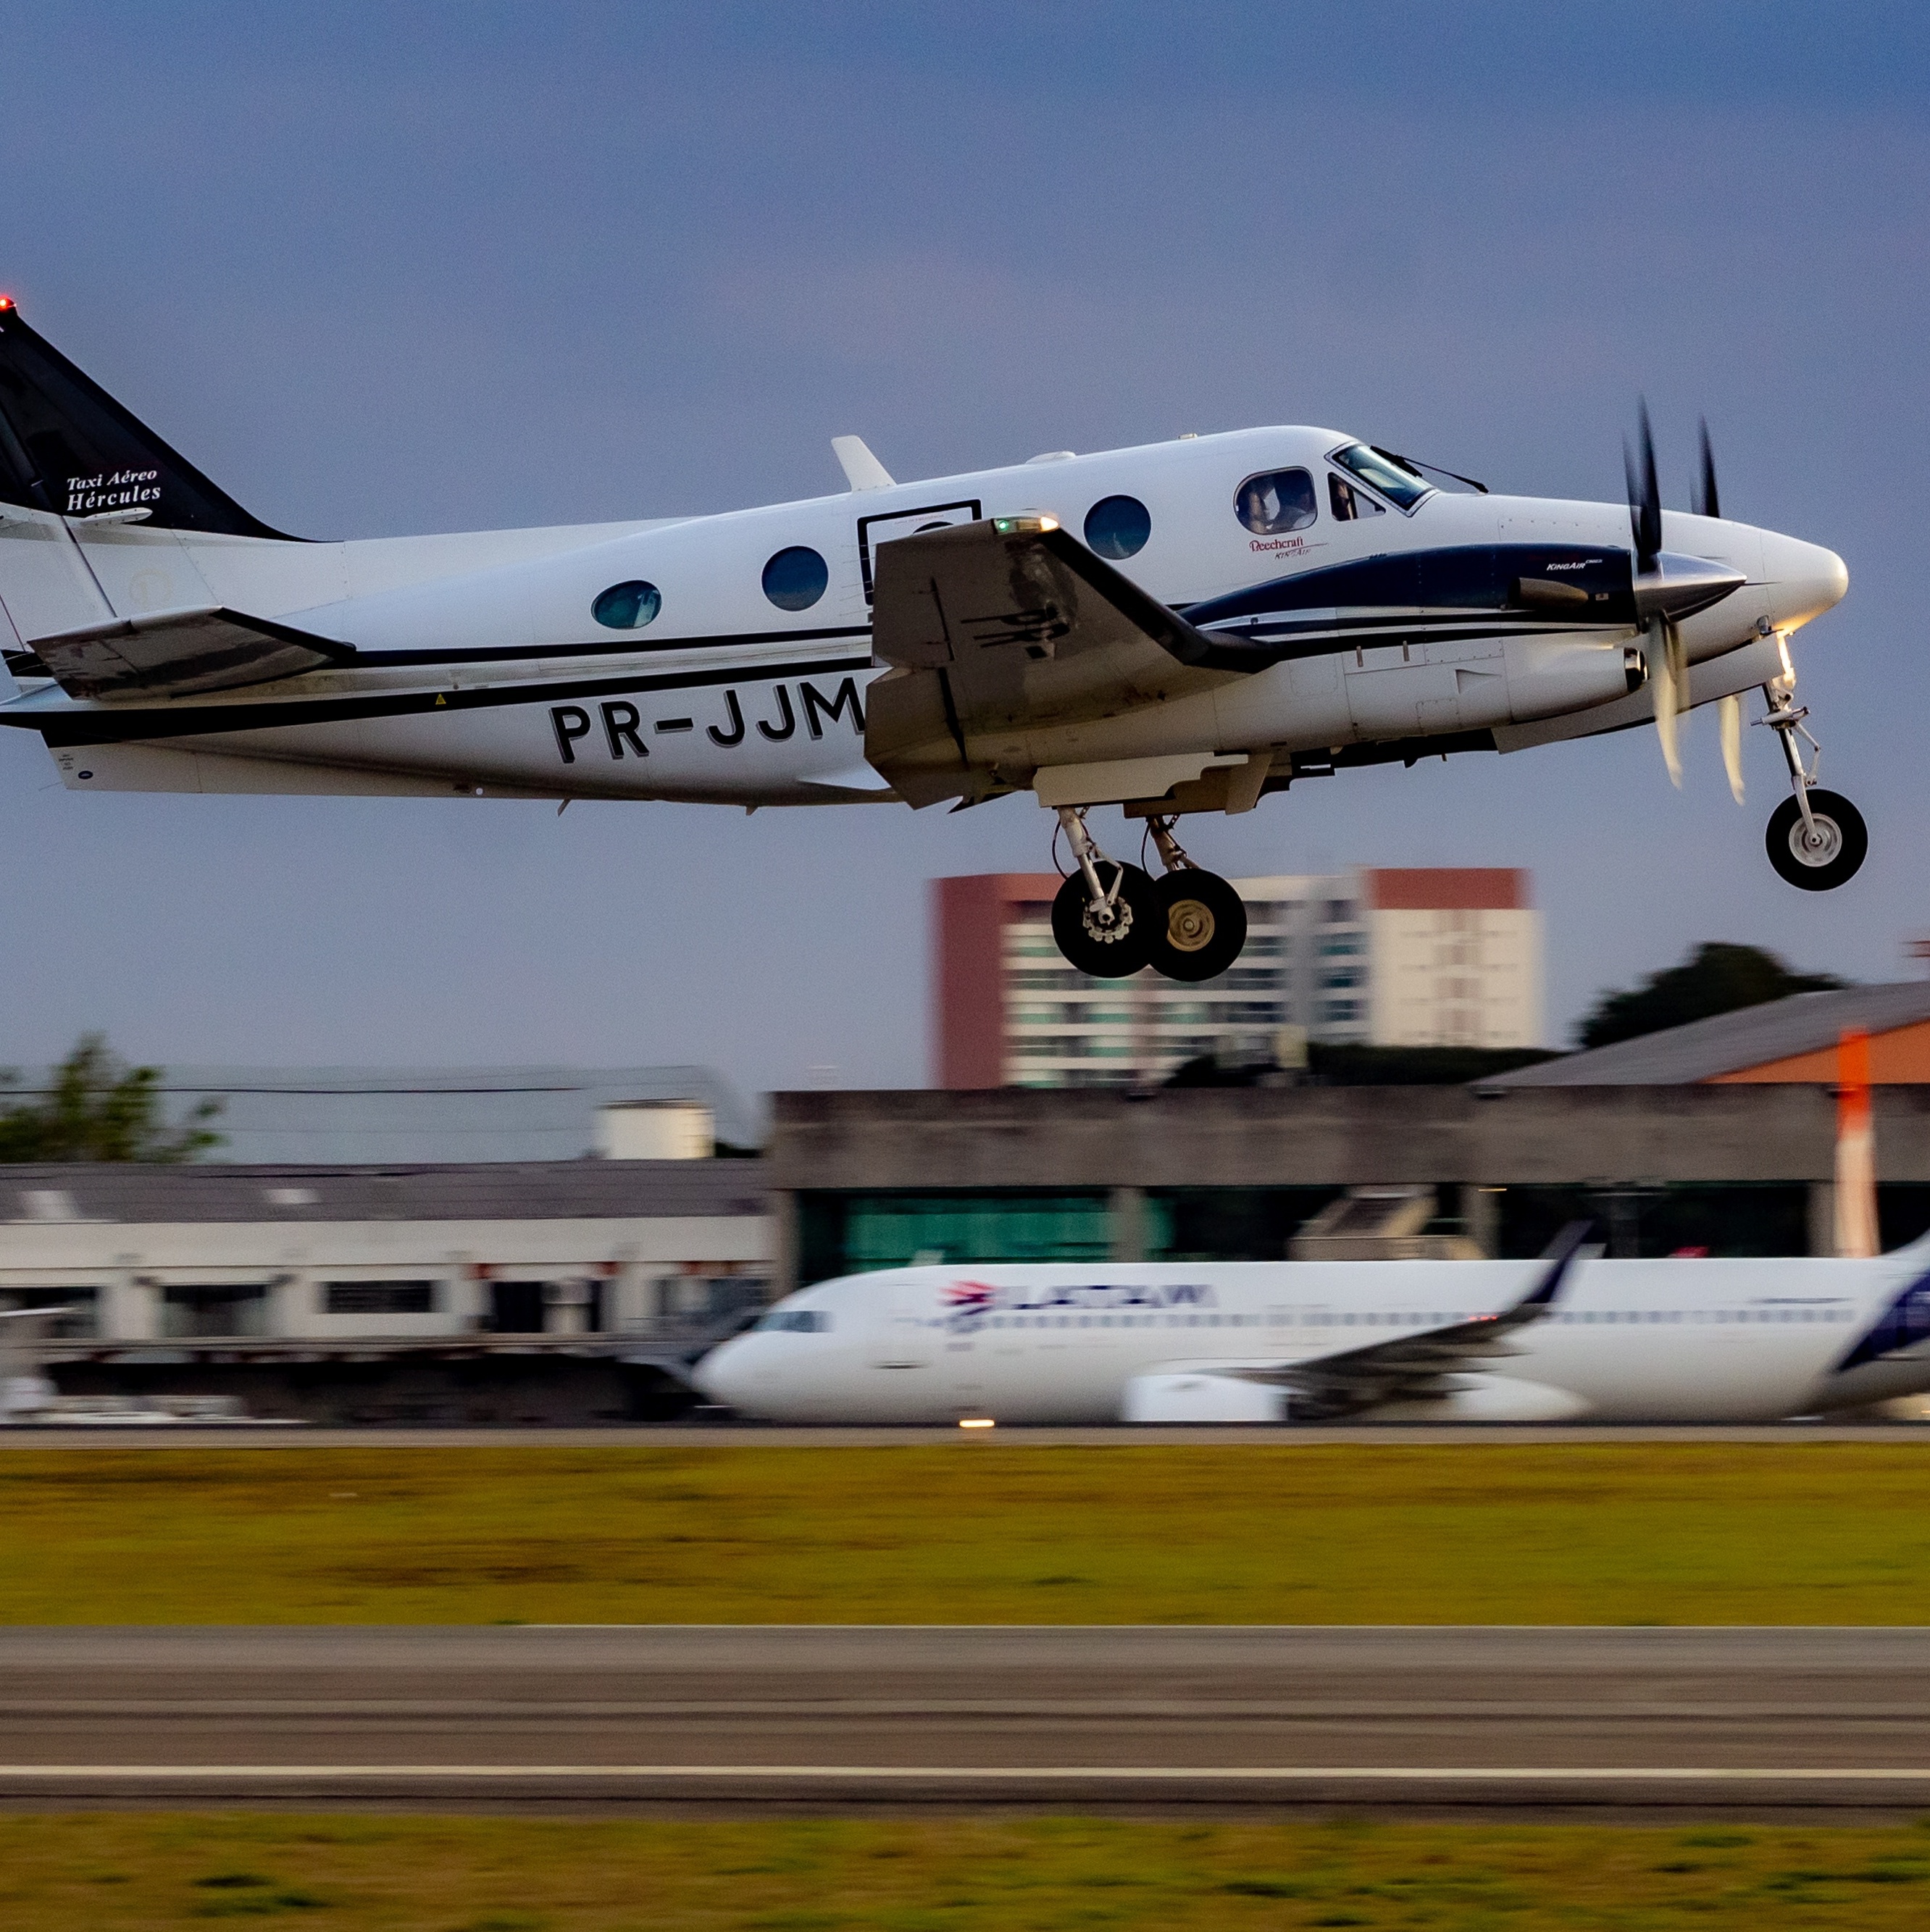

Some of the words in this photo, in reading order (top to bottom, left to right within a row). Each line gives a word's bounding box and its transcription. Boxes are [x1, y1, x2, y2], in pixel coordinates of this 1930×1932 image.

[67, 474, 103, 490] Taxi
[106, 470, 157, 485] Aéreo
[67, 485, 161, 511] Hércules
[548, 677, 865, 764] PR-JJM
